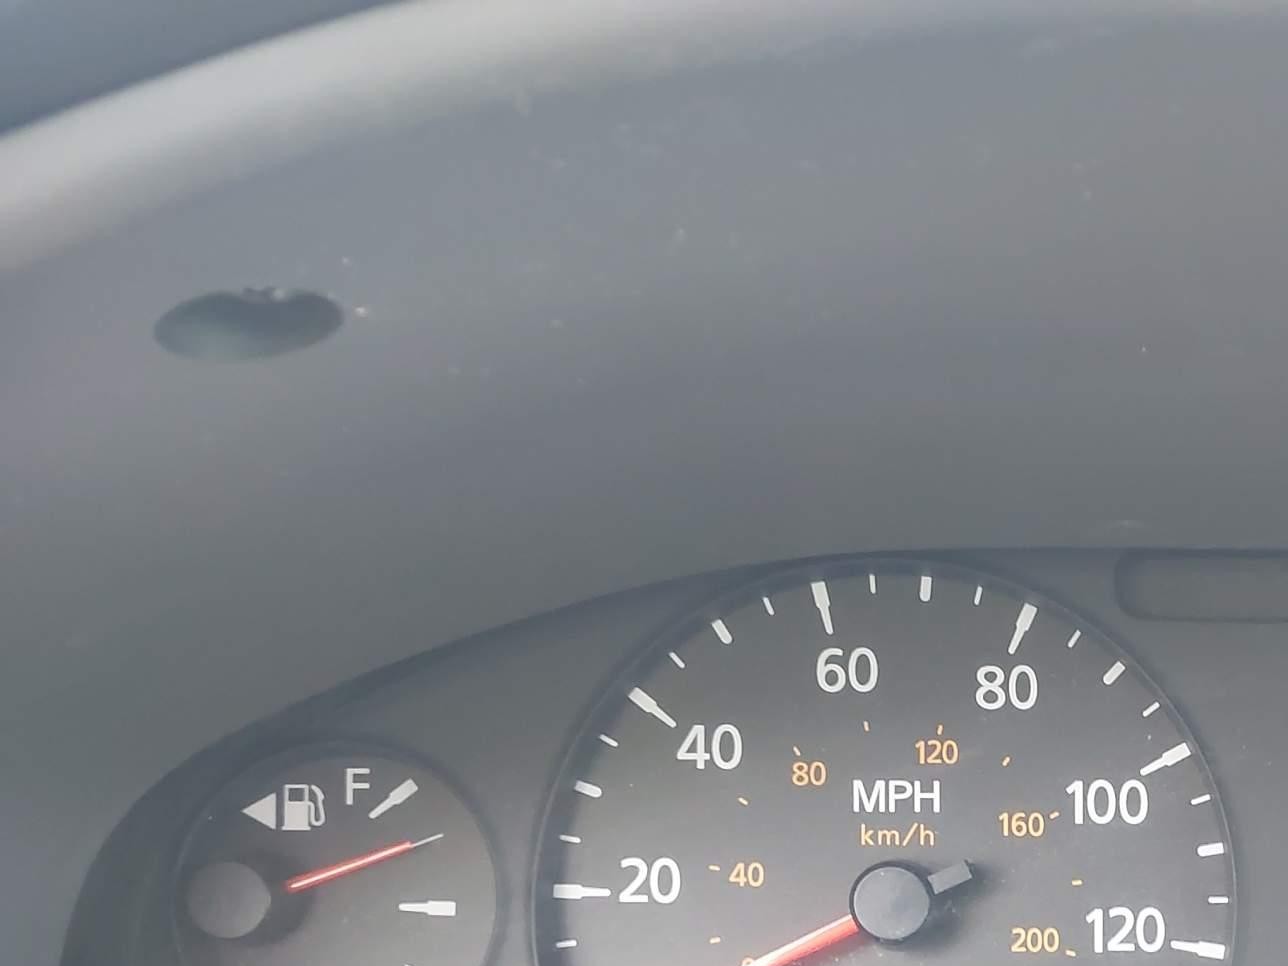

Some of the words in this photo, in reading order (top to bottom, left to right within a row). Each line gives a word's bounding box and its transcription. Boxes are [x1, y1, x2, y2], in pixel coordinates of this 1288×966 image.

[817, 648, 878, 692] 60
[976, 665, 1037, 709] 80
[677, 724, 742, 769] 40
[916, 740, 958, 764] 120
[346, 768, 370, 805] F
[792, 762, 826, 785] 80
[853, 780, 940, 812] MPH
[1066, 780, 1148, 824] 100
[861, 823, 934, 846] km/h
[999, 813, 1044, 836] 160
[619, 858, 680, 903] 20
[729, 863, 763, 886] 40
[1012, 928, 1059, 952] 200
[1086, 907, 1165, 953] 120
